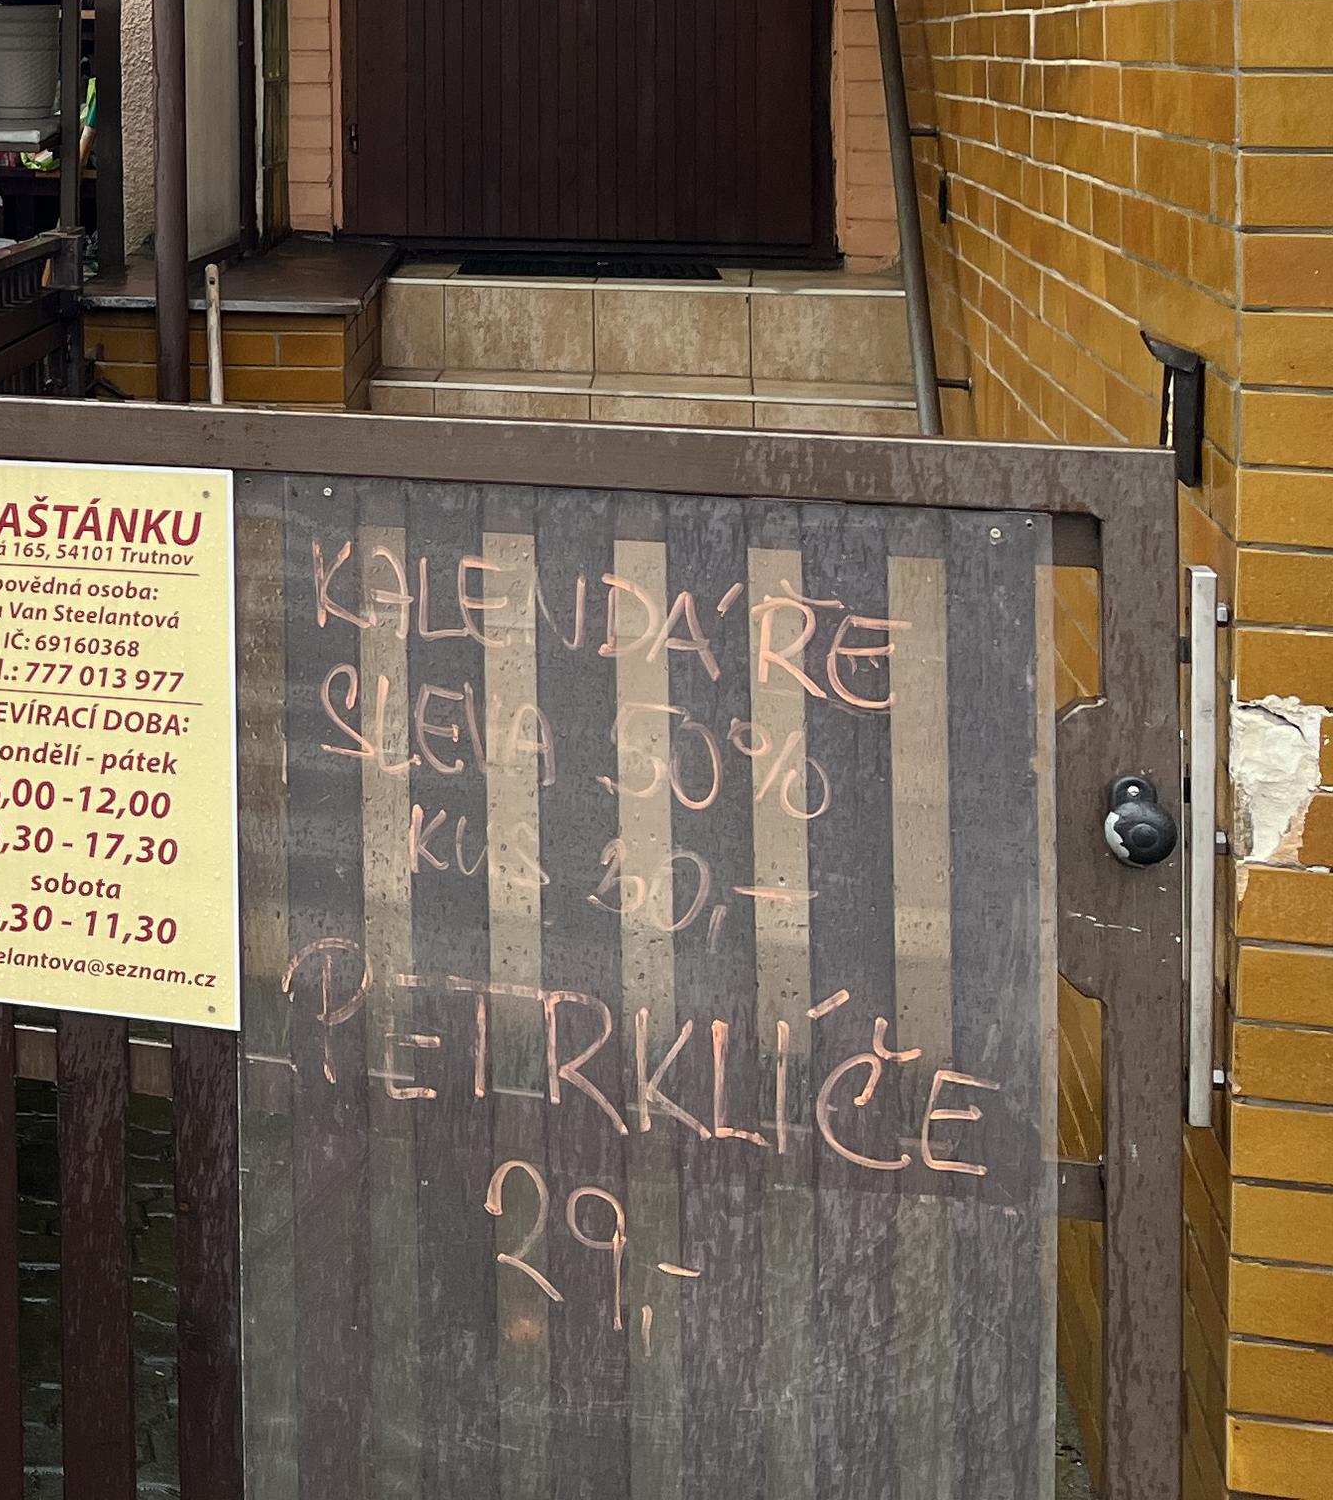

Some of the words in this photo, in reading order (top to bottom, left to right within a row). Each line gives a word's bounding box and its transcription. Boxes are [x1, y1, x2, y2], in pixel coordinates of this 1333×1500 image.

[13, 542, 51, 561] 165,
[57, 544, 113, 562] 54101
[121, 547, 194, 566] Trutnov
[87, 580, 159, 600] osoba:
[9, 601, 48, 621] Van
[53, 604, 180, 629] Steelantová
[3, 629, 30, 650] IČ:
[35, 634, 140, 657] 69160368
[25, 662, 73, 685] 777
[79, 665, 127, 689] 013
[135, 669, 184, 693] 977
[102, 709, 190, 737] DOBA:
[319, 663, 557, 788] SLEVA
[99, 748, 179, 775] pátek
[85, 831, 179, 866] 17,30
[30, 872, 123, 900] sobota
[85, 910, 179, 945] 11,30
[281, 935, 1001, 1177] PETRKLÍČE
